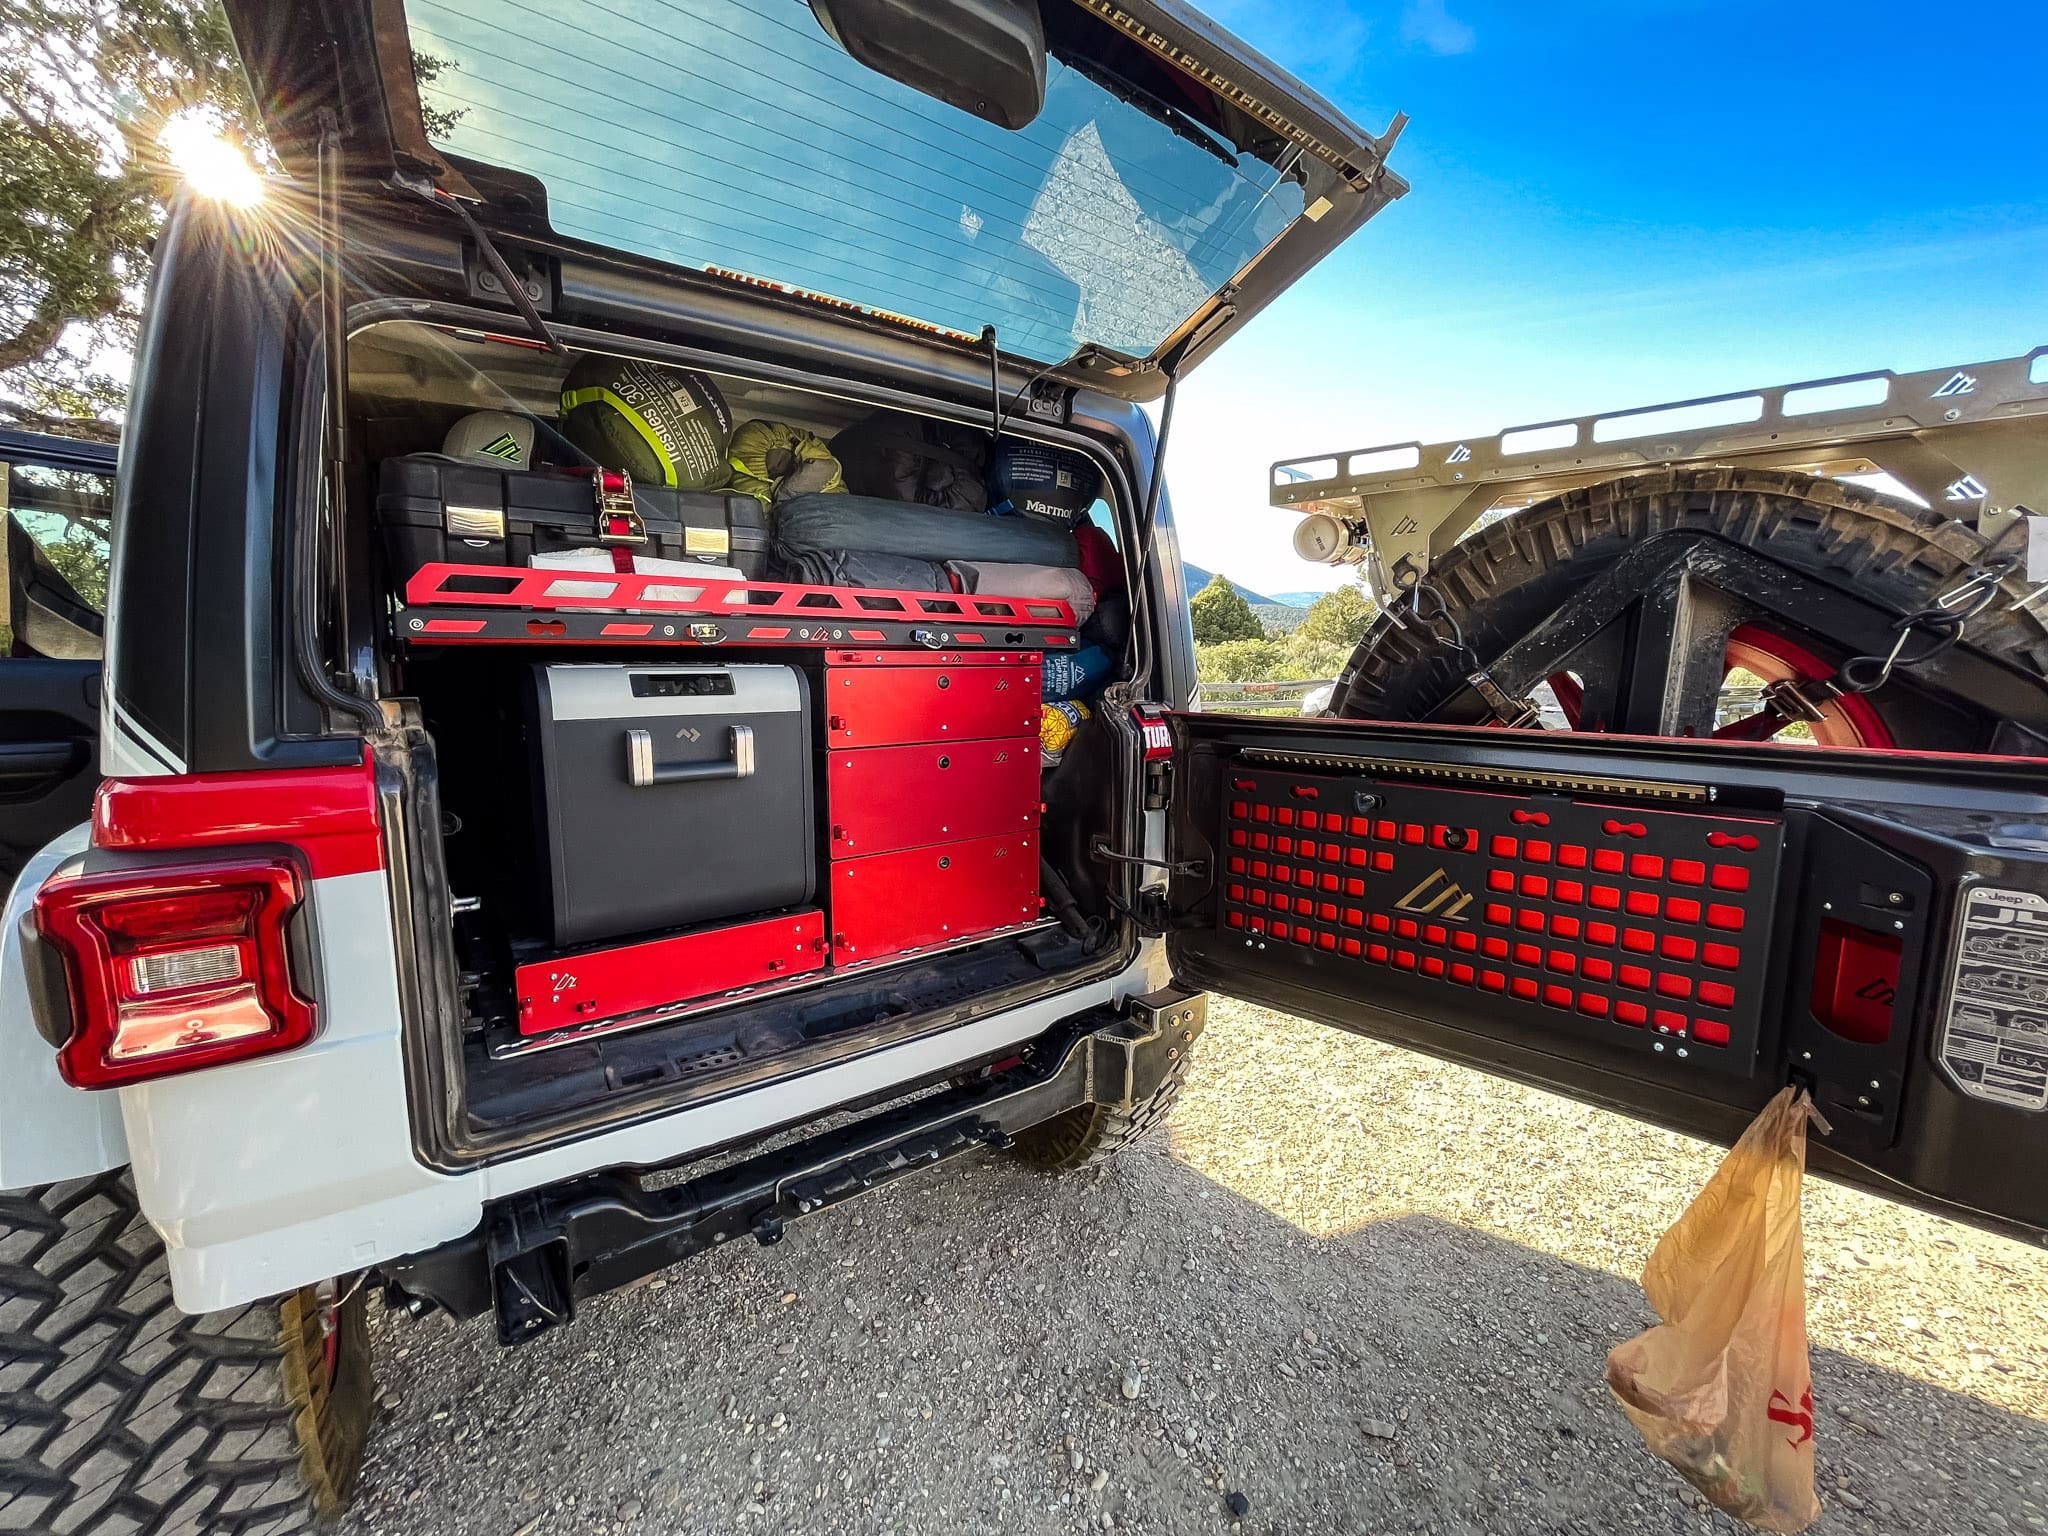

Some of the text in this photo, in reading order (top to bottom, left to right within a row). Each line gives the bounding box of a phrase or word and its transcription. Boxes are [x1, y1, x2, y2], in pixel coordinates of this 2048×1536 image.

[678, 396, 689, 407] EN
[1054, 658, 1062, 673] CAMP
[1143, 726, 1172, 748] TUR
[1988, 892, 2023, 905] Jeep
